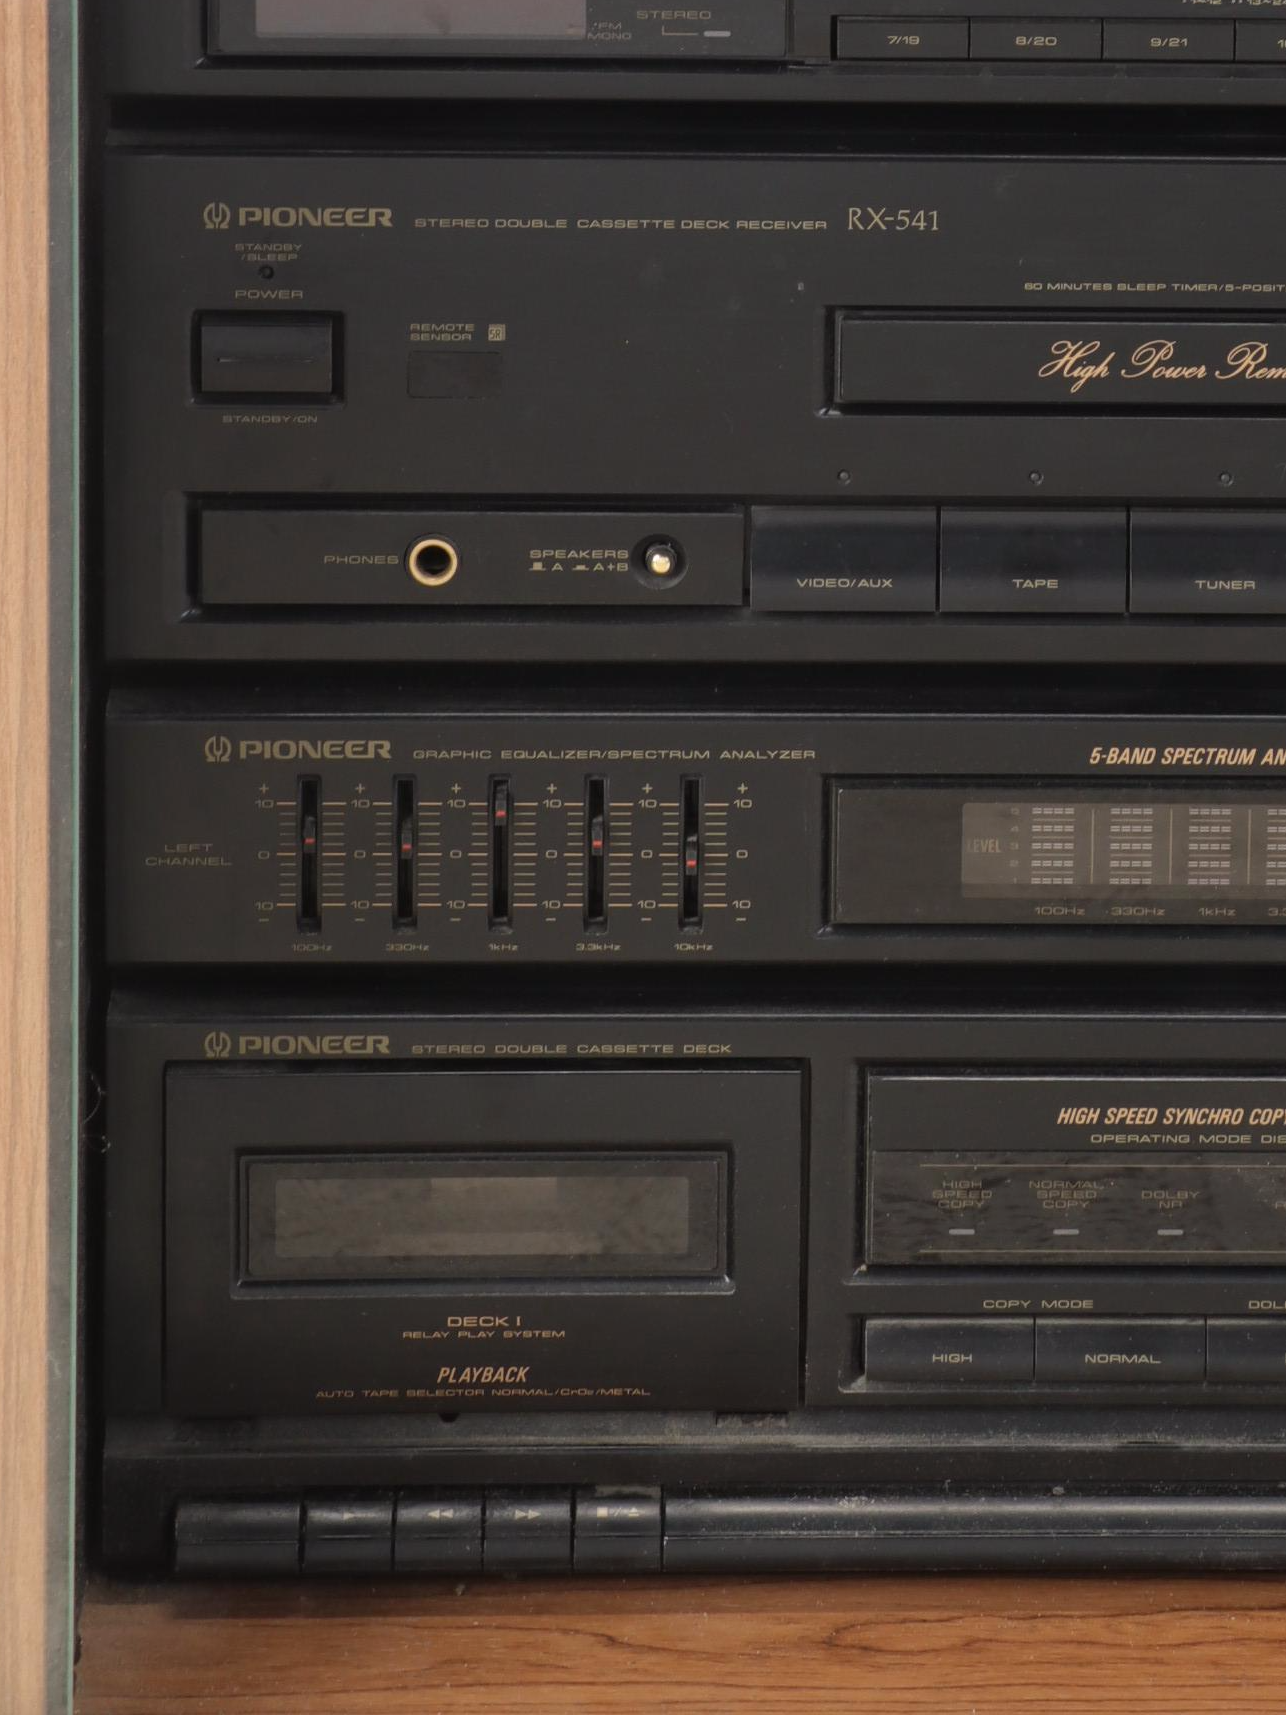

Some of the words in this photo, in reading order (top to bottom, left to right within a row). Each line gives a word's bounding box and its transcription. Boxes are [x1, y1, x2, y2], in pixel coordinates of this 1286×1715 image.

[238, 207, 393, 227] PIONEER
[847, 207, 939, 231] RX-541
[414, 218, 490, 228] STEREO
[494, 218, 568, 229] DOUBLE
[576, 219, 676, 229] CASSETTE
[680, 219, 730, 230] DECK
[736, 220, 827, 230] RECEIVER
[1046, 282, 1113, 291] MINUTES
[234, 289, 304, 300] POWER
[1036, 339, 1110, 394] High
[1120, 339, 1208, 379] Power
[529, 549, 629, 559] SPEAKERS
[323, 555, 400, 565] PHONES
[796, 578, 893, 588] VIDEO/AUX
[1012, 579, 1059, 589] TAPE
[1194, 580, 1256, 590] TUNER
[239, 739, 392, 760] PIONEER
[412, 749, 492, 760] GRAPHIC
[500, 749, 710, 760] EQUALIZER/SPECTRUM
[719, 750, 816, 760] ANALYZER
[1089, 747, 1157, 765] 5-BAND
[1160, 747, 1257, 765] SPECTRUM
[238, 1035, 391, 1055] PIONEER
[411, 1044, 486, 1054] STEREO
[494, 1044, 568, 1054] DOUBLE
[576, 1044, 674, 1054] CASSETTE
[683, 1044, 732, 1054] DECK
[1056, 1107, 1101, 1125] HIGH
[1104, 1107, 1159, 1125] SPEED
[1162, 1107, 1245, 1125] SYNCHRO
[1090, 1134, 1191, 1144] OPERATING
[1198, 1134, 1252, 1144] MODE
[982, 1299, 1032, 1309] COPY
[1041, 1299, 1094, 1309] MODE
[447, 1316, 509, 1327] DECK
[402, 1331, 450, 1339] RELAY
[457, 1330, 496, 1339] PLAY
[503, 1330, 566, 1338] SYSTEM
[932, 1353, 973, 1363] HIGH
[1084, 1353, 1162, 1364] NORMAL
[436, 1366, 530, 1383] PLAYBACK
[315, 1389, 355, 1398] AUTO
[361, 1389, 399, 1397] TAPE
[406, 1388, 485, 1397] SELECTOR
